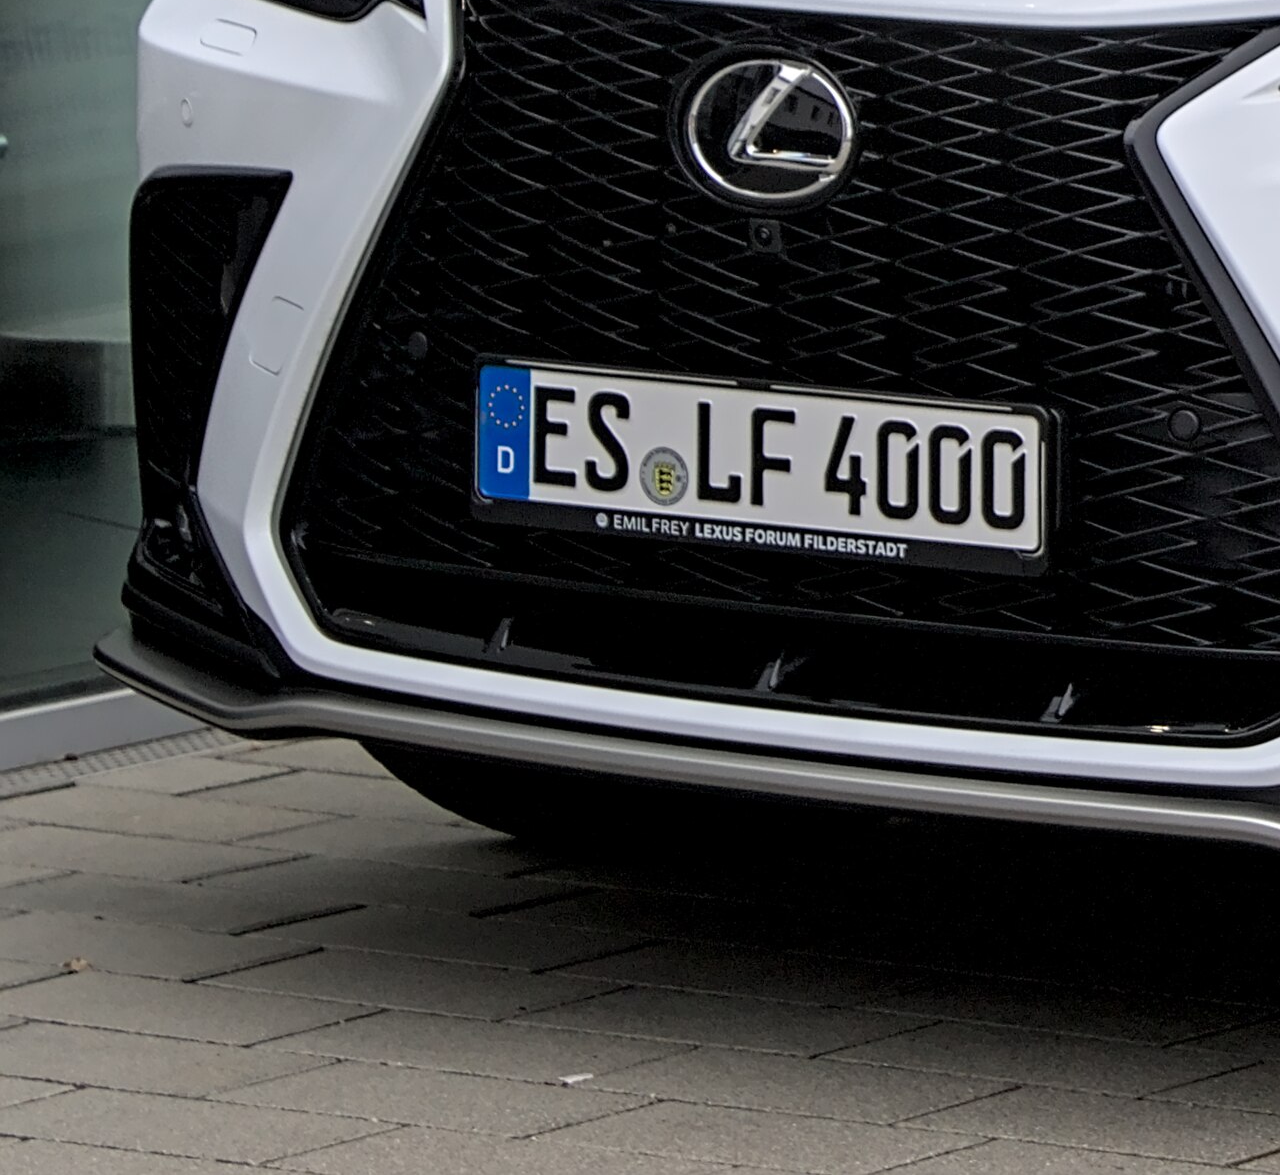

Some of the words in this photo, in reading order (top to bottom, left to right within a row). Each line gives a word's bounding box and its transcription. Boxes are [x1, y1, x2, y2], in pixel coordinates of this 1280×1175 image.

[497, 445, 515, 474] D
[532, 384, 632, 493] ES
[696, 399, 797, 507] LF
[823, 415, 1027, 531] 4000
[612, 513, 650, 533] EMIL
[650, 518, 690, 537] FREY
[694, 523, 743, 543] LEXUS
[744, 528, 802, 548] FORUM
[803, 534, 907, 559] FILDERSTADT
